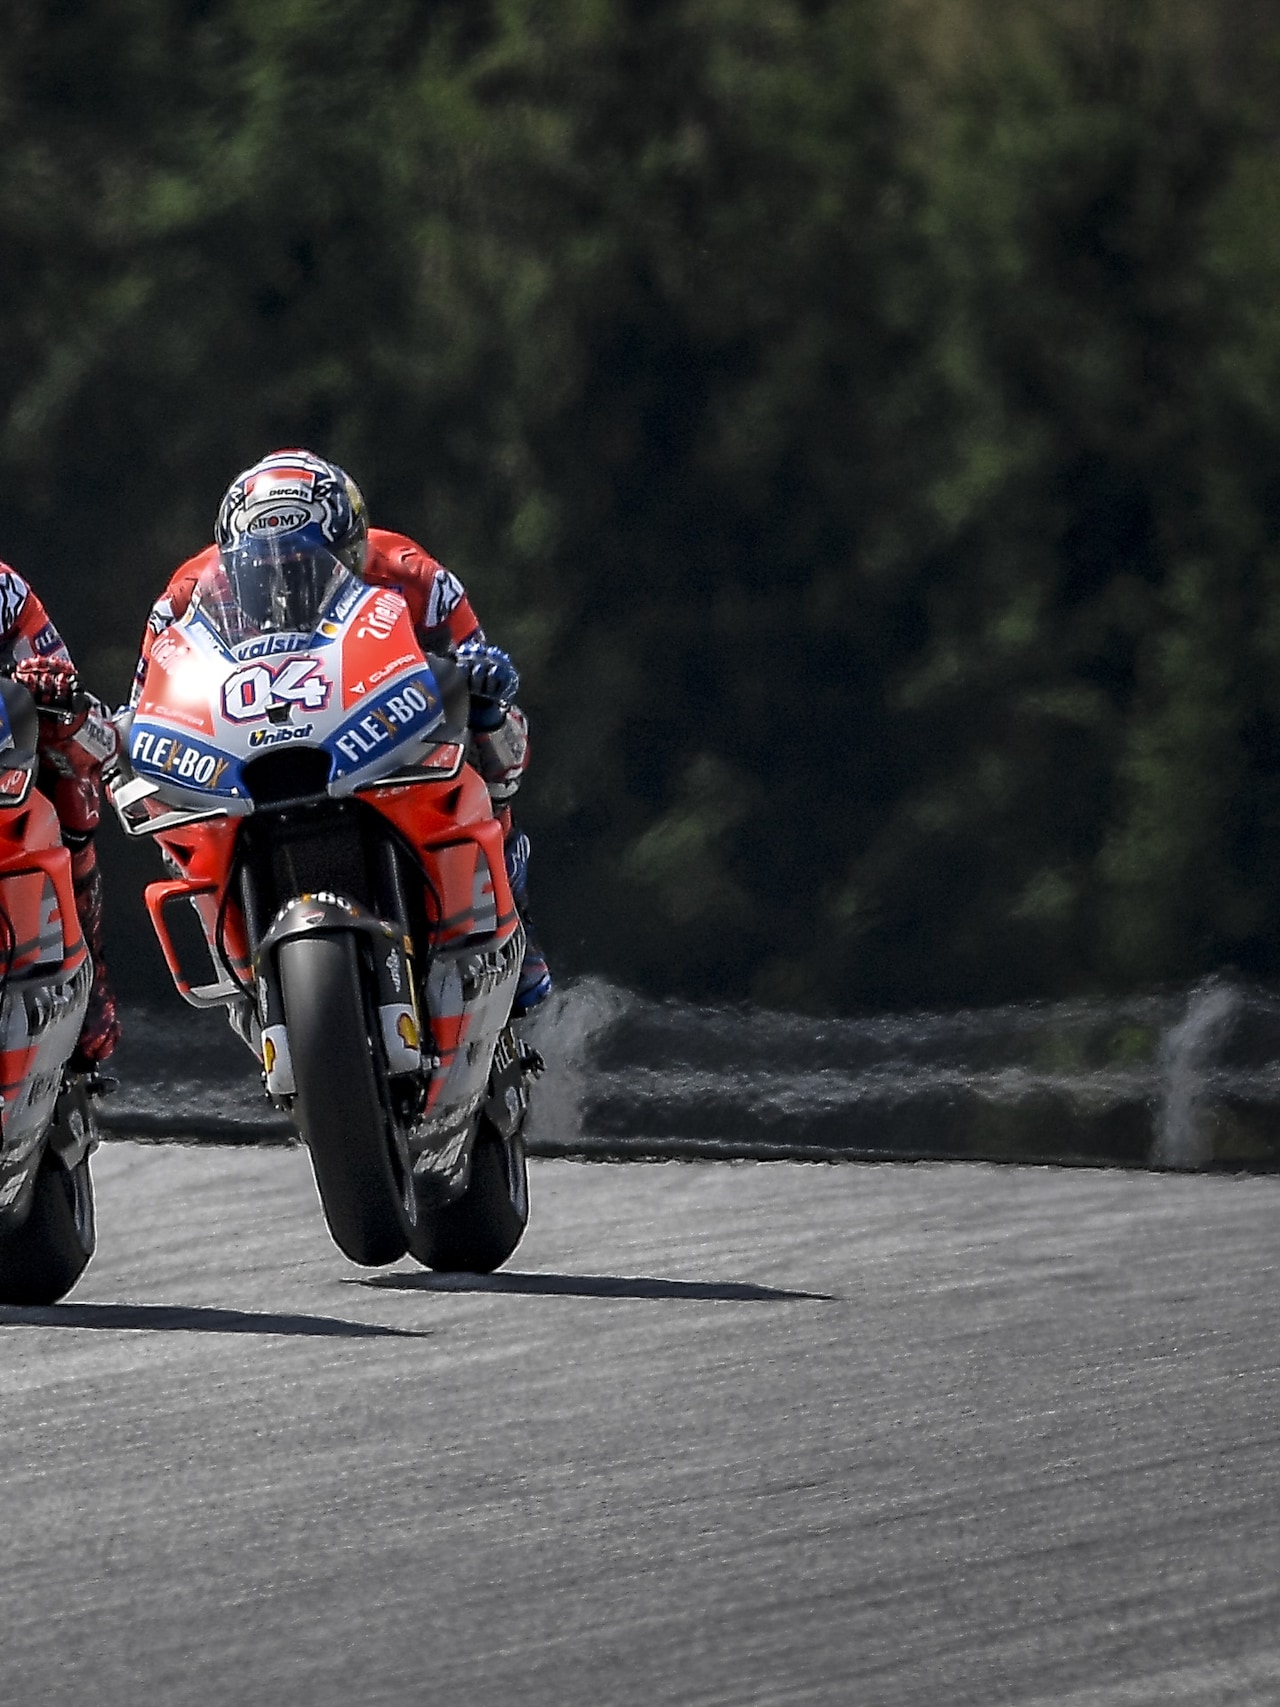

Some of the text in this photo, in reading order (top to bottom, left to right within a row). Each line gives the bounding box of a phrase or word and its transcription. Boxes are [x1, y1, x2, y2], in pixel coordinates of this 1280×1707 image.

[251, 514, 305, 531] SUOMY
[239, 635, 308, 660] valsir
[220, 655, 333, 727] 04
[249, 724, 314, 747] Unibat
[335, 680, 438, 763] FLEX-BOX
[132, 731, 230, 788] FLEX-BOX
